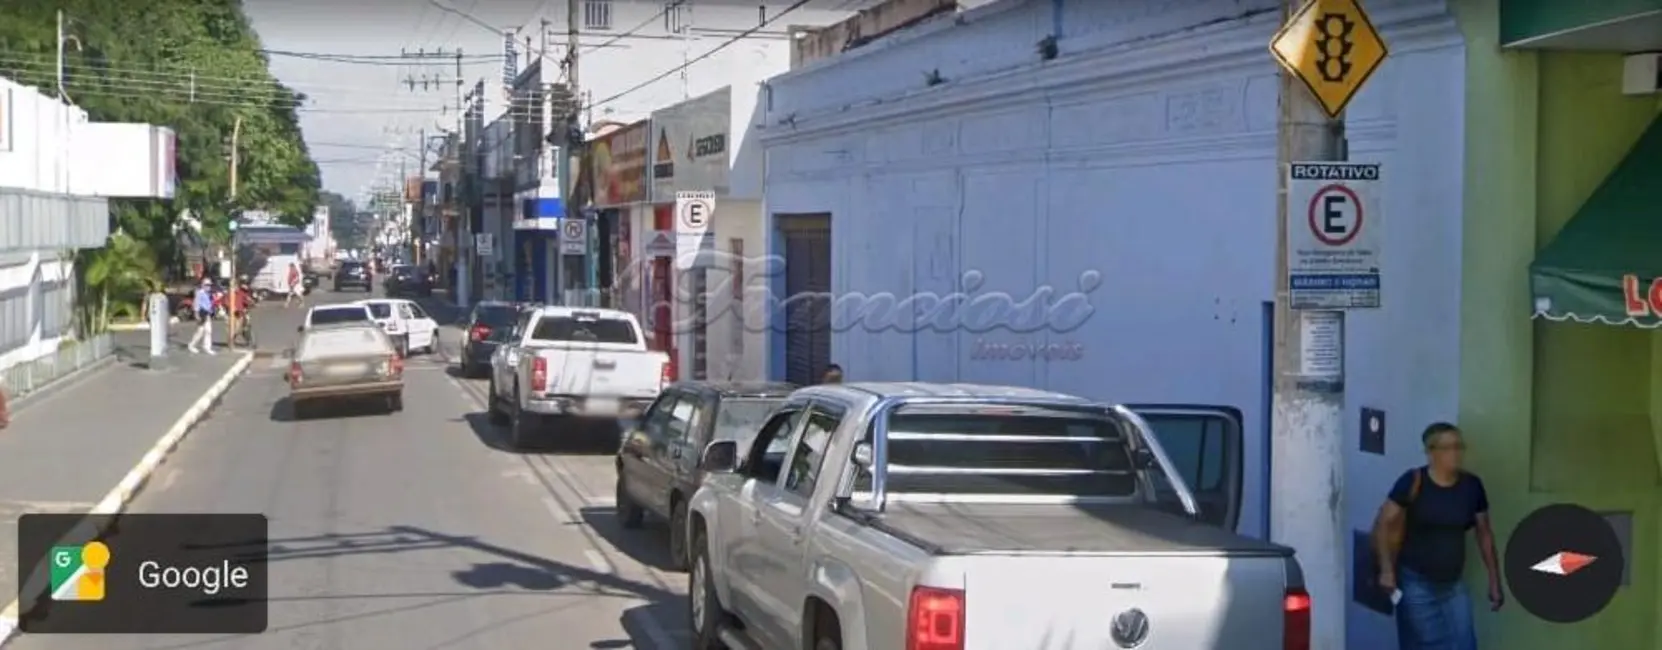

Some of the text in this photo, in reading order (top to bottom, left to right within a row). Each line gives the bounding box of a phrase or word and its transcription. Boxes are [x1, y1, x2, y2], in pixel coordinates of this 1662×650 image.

[1294, 165, 1377, 179] ROTATIVO
[690, 204, 702, 223] E
[1323, 196, 1346, 233] E
